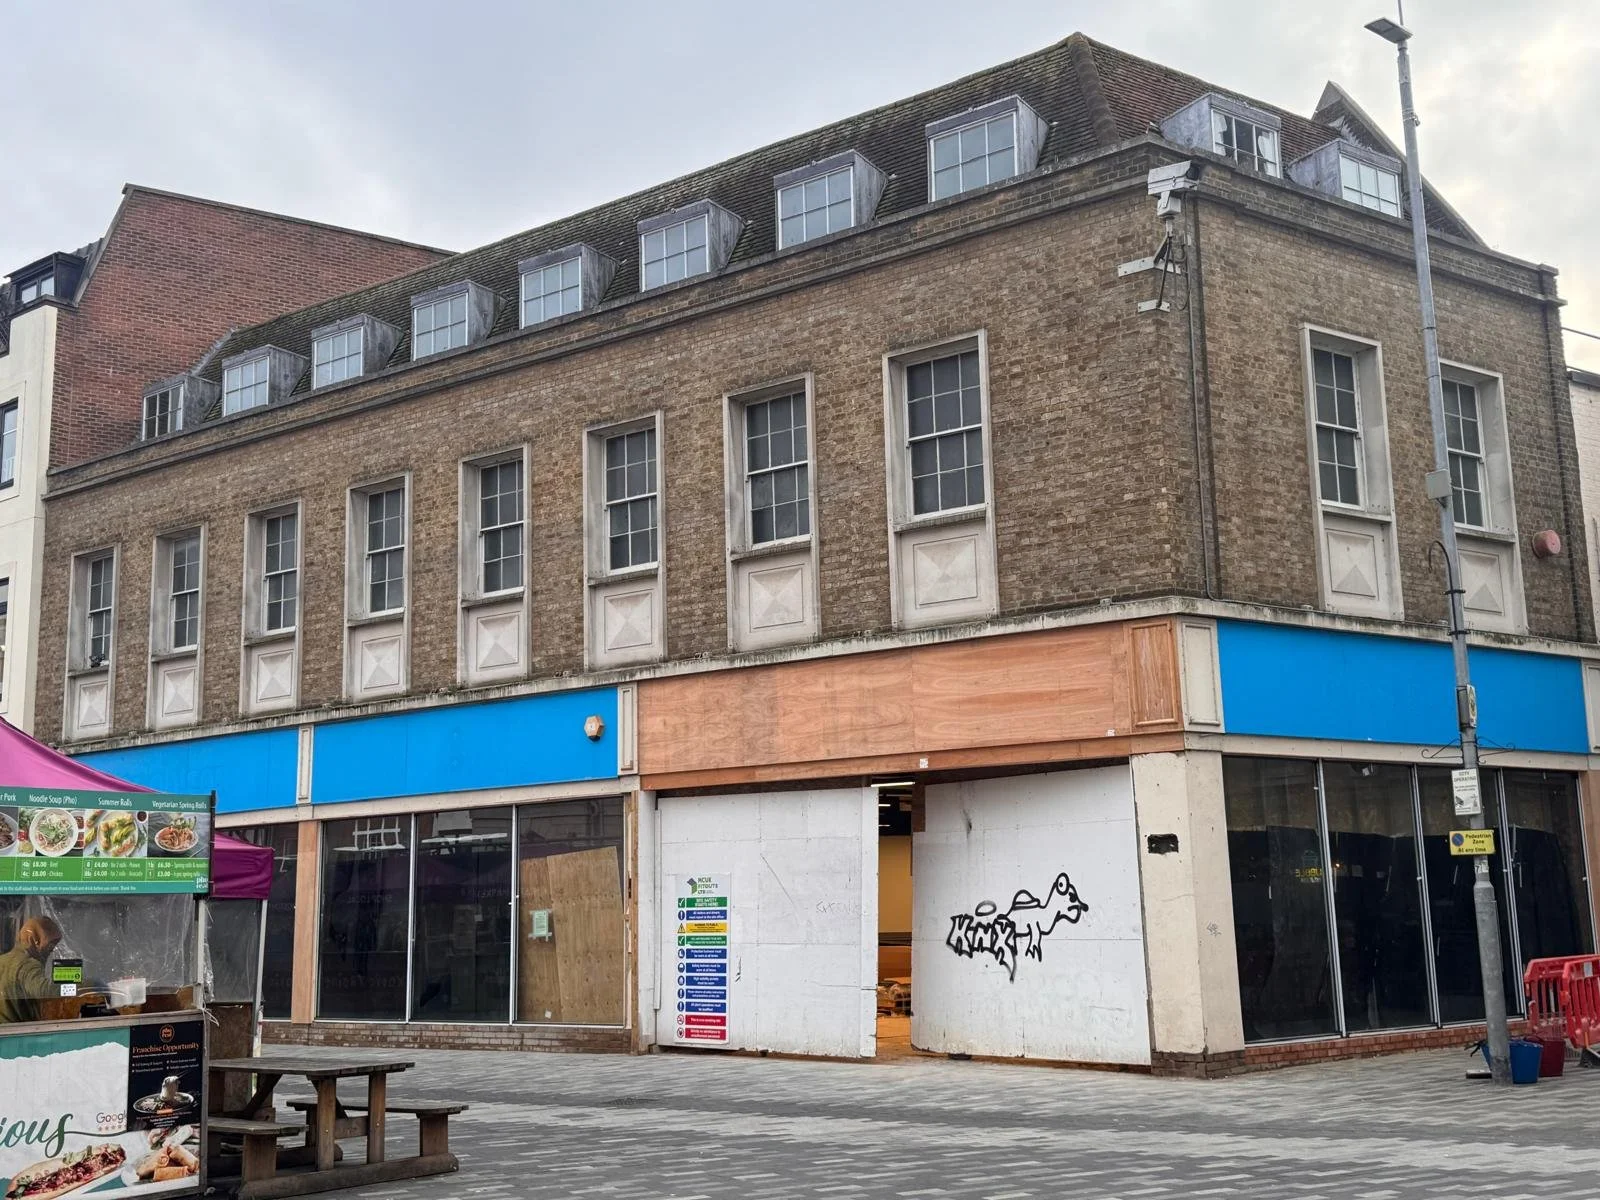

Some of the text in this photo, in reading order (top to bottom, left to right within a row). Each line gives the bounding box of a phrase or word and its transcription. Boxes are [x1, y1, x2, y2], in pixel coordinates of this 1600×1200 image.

[4, 793, 17, 802] Pork
[29, 794, 78, 805] Noodle Soup (Pho)
[98, 797, 133, 807] Summer Rolls
[152, 800, 207, 810] Vegetarian Spring Rolls
[132, 1041, 199, 1054] Franchise Opportunity
[96, 1109, 127, 1124] Googl
